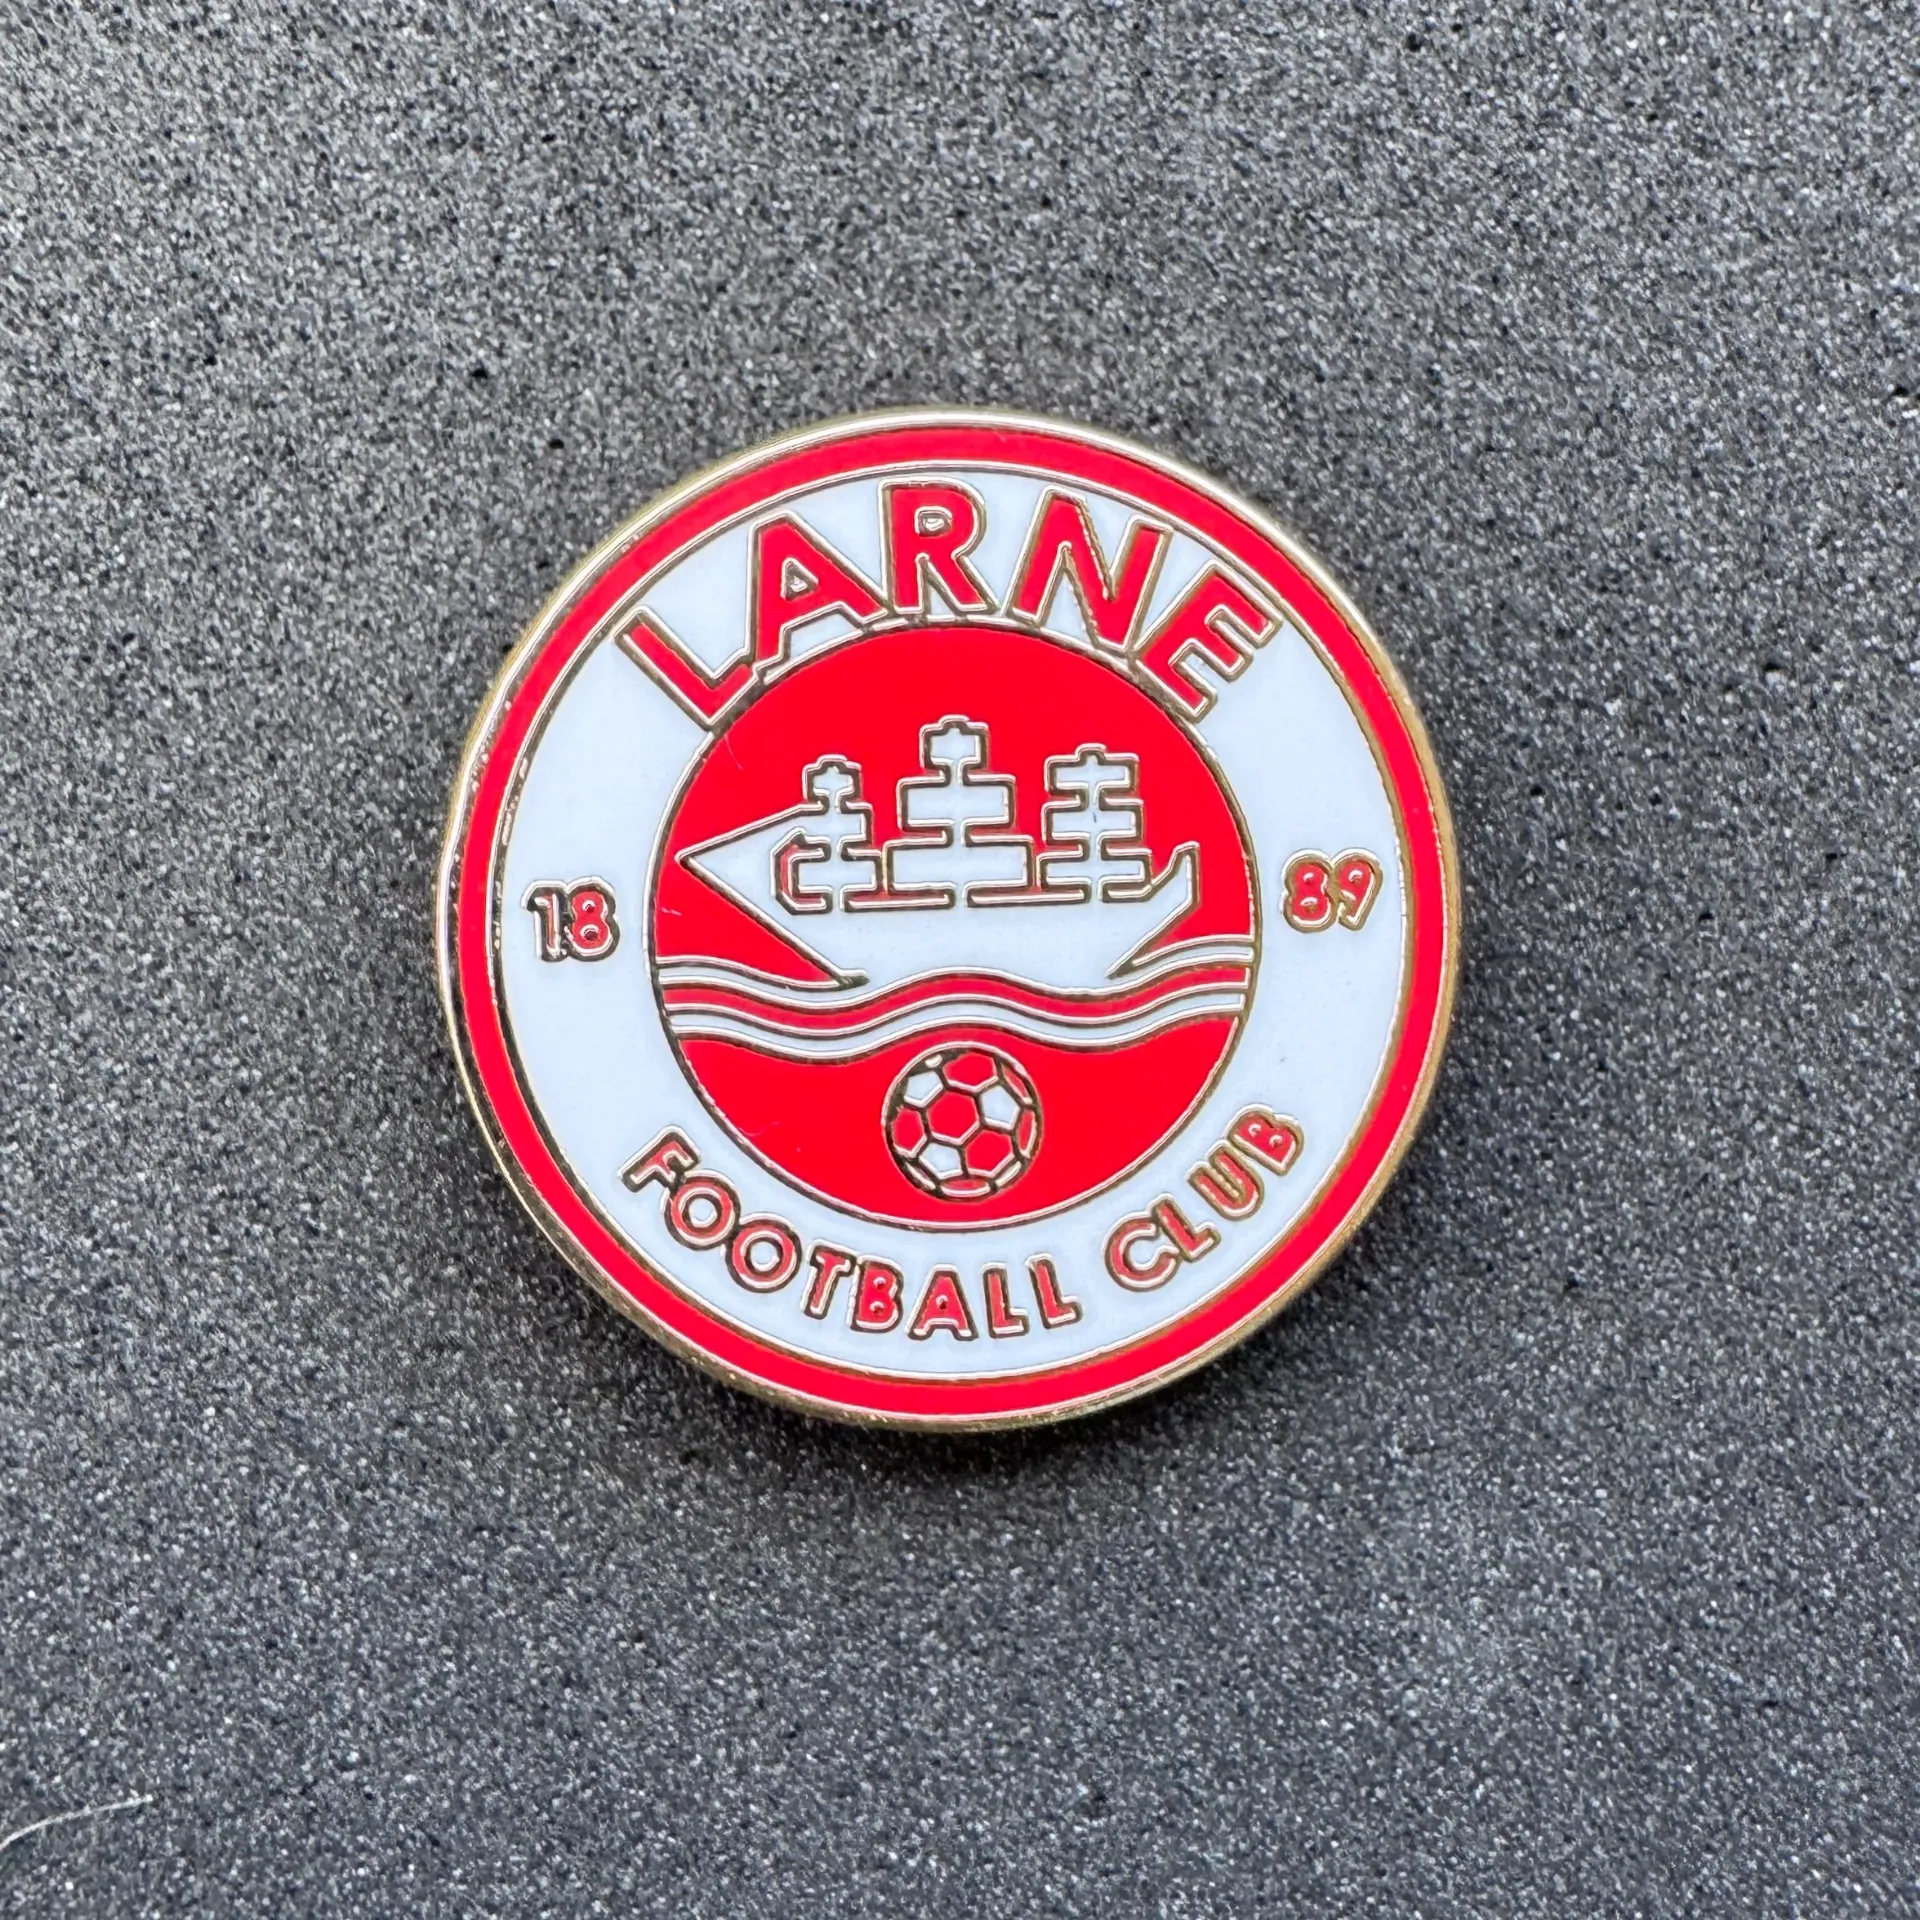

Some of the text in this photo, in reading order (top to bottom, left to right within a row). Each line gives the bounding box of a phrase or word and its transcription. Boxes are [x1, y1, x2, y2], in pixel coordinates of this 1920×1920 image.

[616, 480, 1284, 728] LARNE
[522, 876, 620, 962] 18
[1281, 848, 1383, 932] 89
[620, 1103, 1305, 1341] FOOTBALL CLUB
